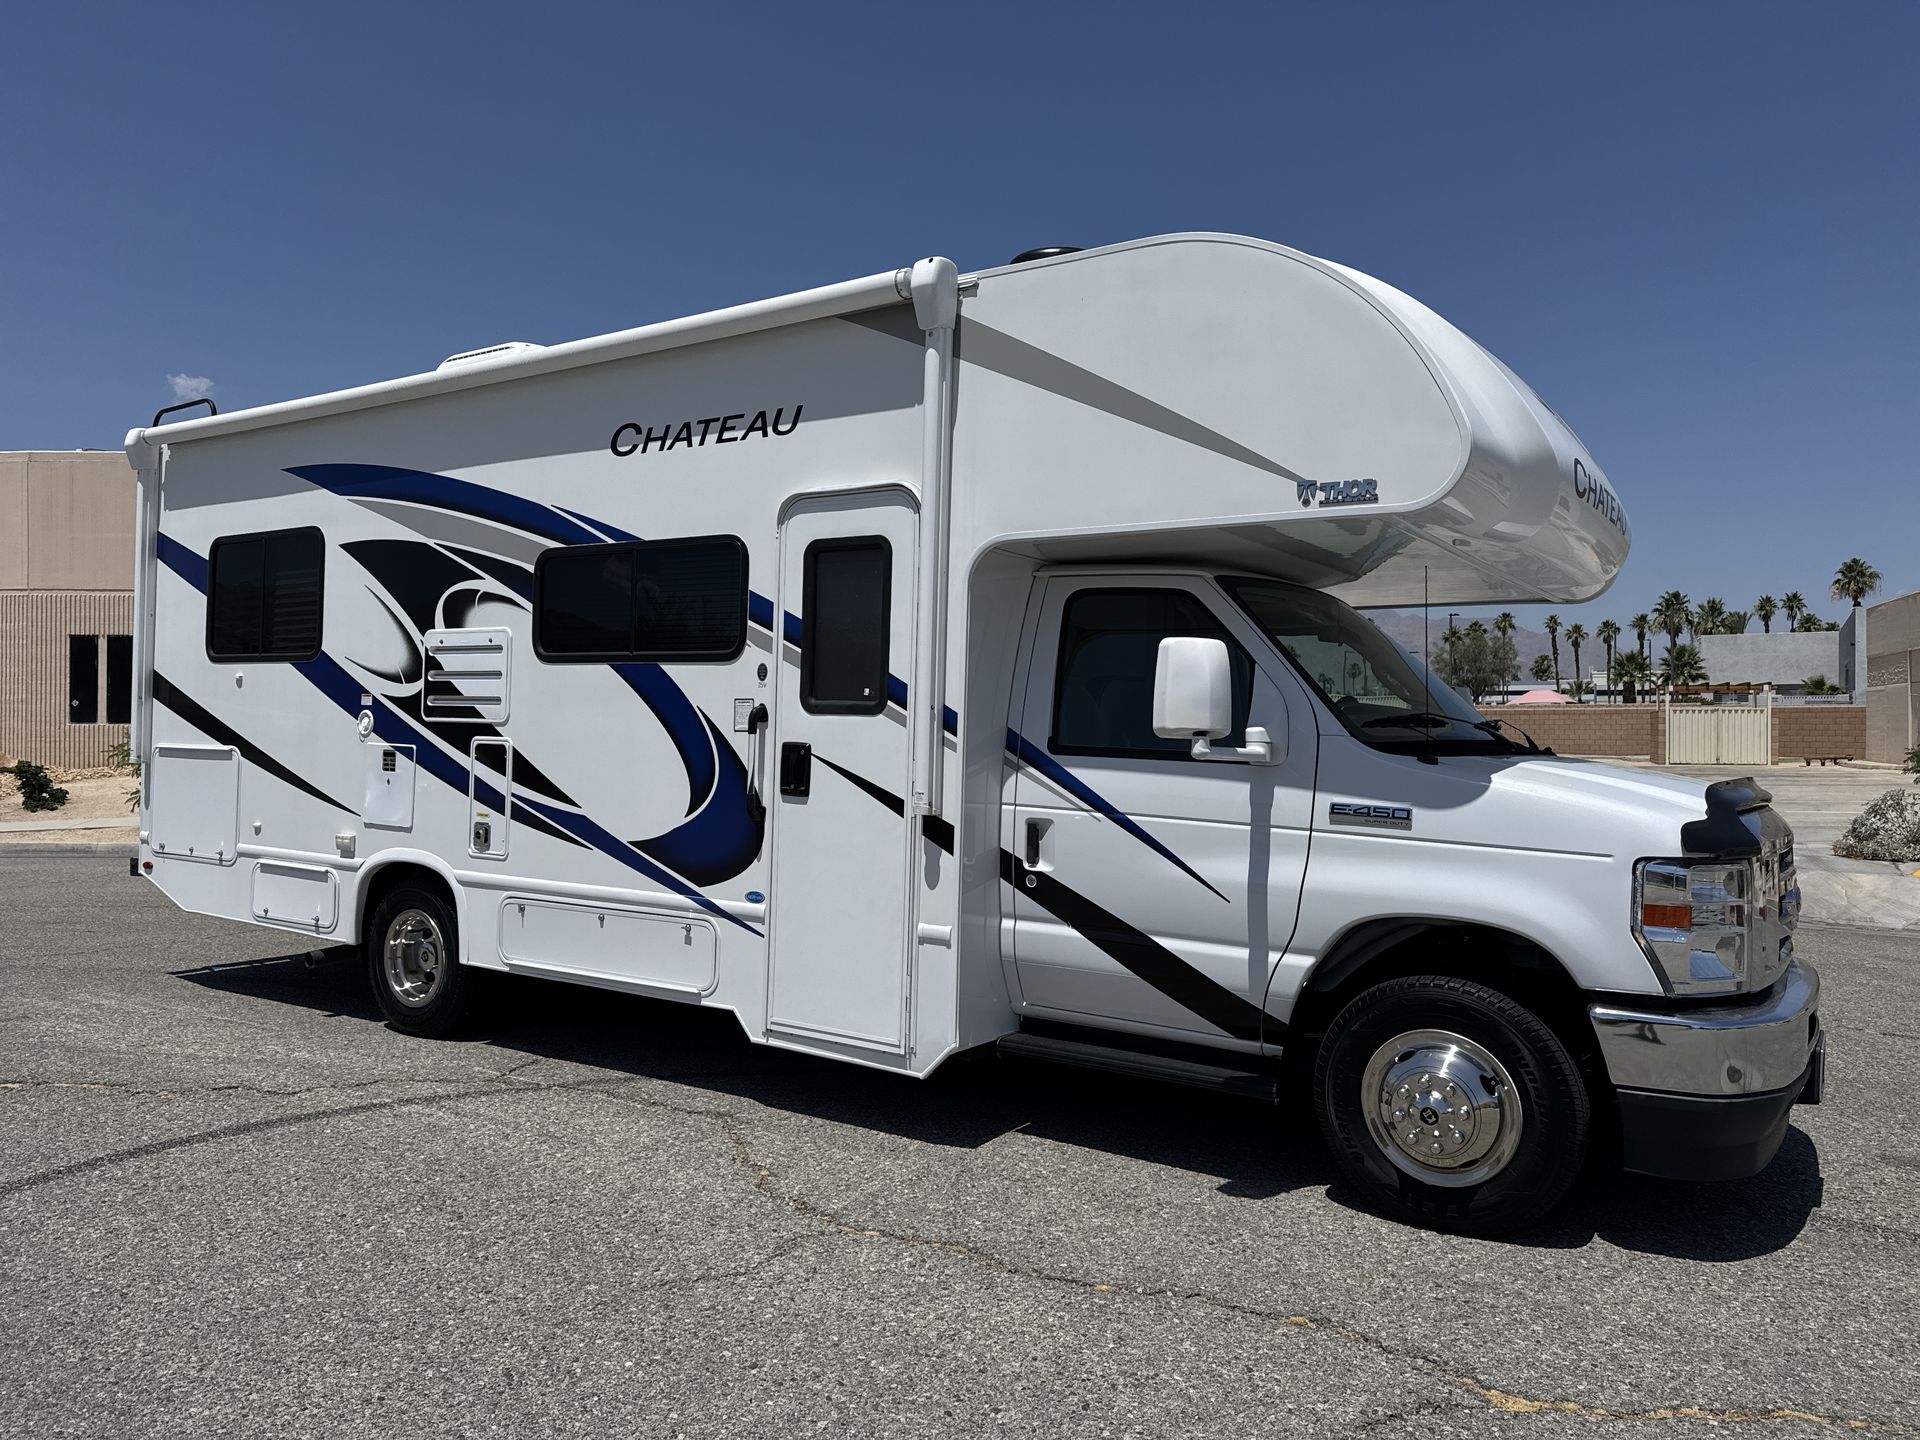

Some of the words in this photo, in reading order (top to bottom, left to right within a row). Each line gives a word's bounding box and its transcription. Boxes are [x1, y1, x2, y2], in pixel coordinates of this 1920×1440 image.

[610, 404, 803, 457] CHATEAU
[1319, 479, 1378, 500] THOR
[1574, 457, 1628, 536] CHATEAU
[1330, 803, 1411, 820] E-450
